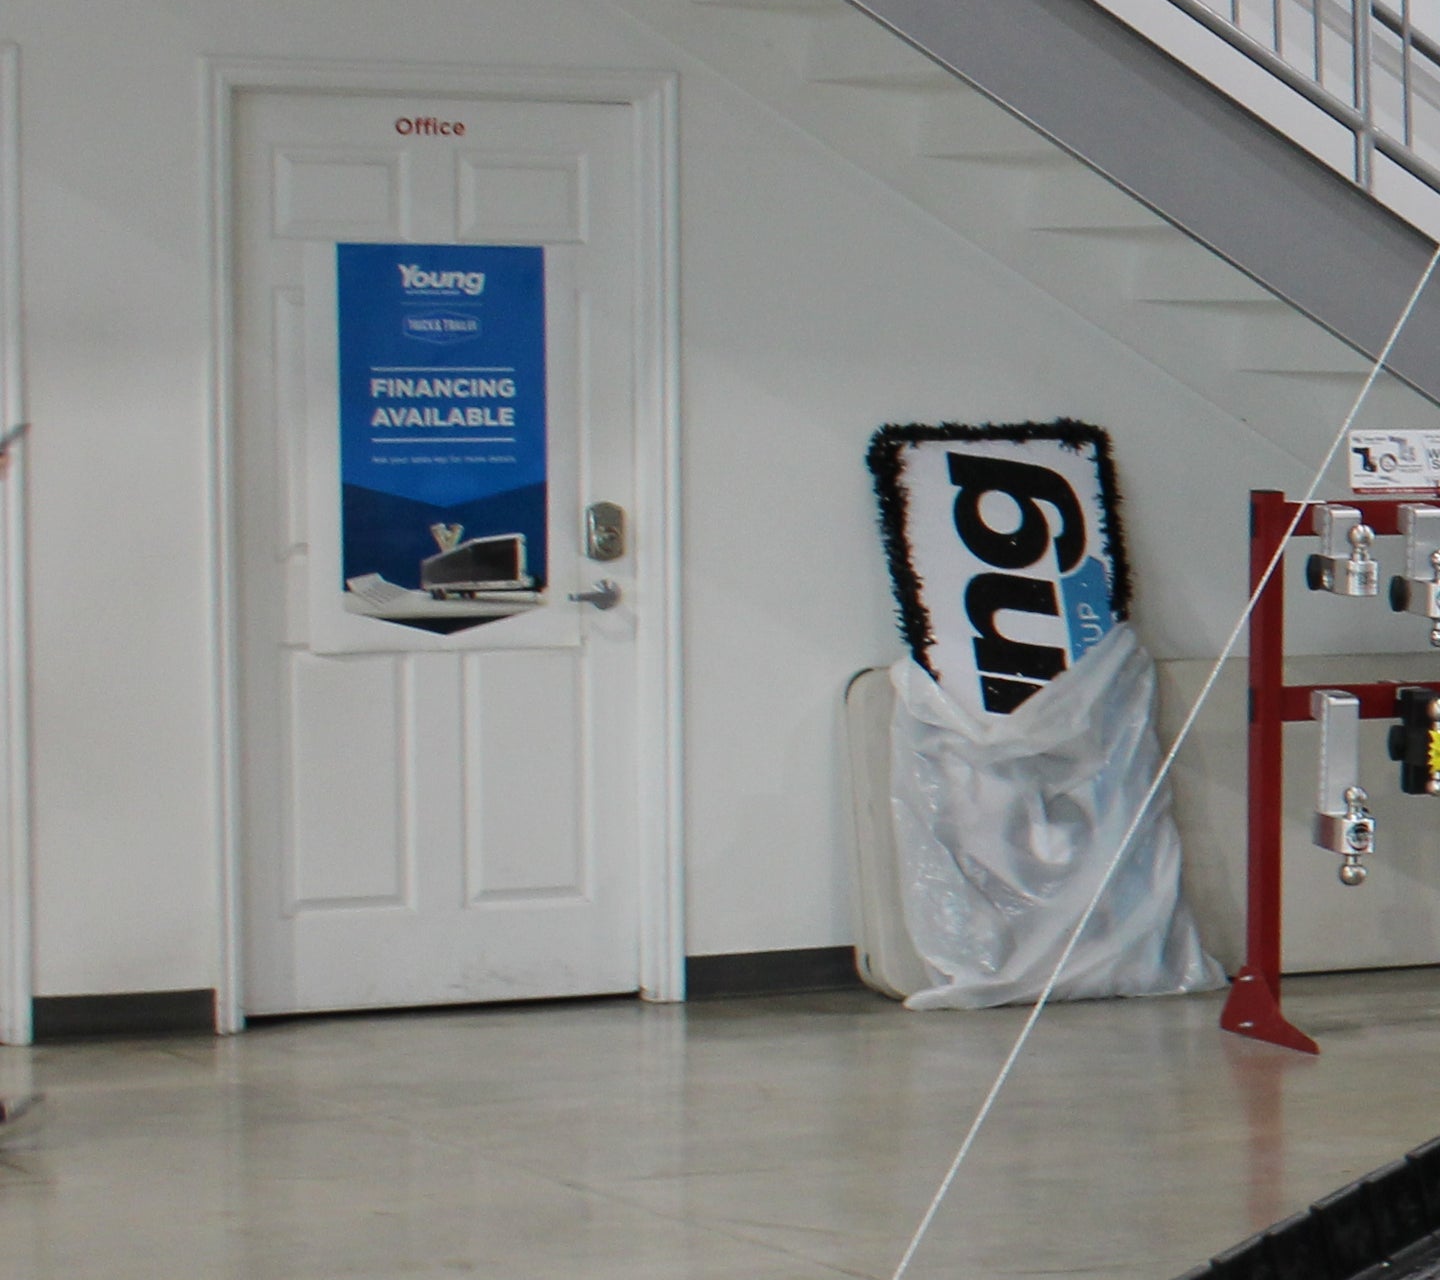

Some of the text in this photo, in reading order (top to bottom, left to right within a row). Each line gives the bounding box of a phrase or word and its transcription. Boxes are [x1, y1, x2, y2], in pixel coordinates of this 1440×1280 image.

[395, 117, 466, 136] Office
[398, 263, 486, 296] Young
[370, 377, 516, 399] FINANCING
[370, 406, 516, 427] AVAILABLE
